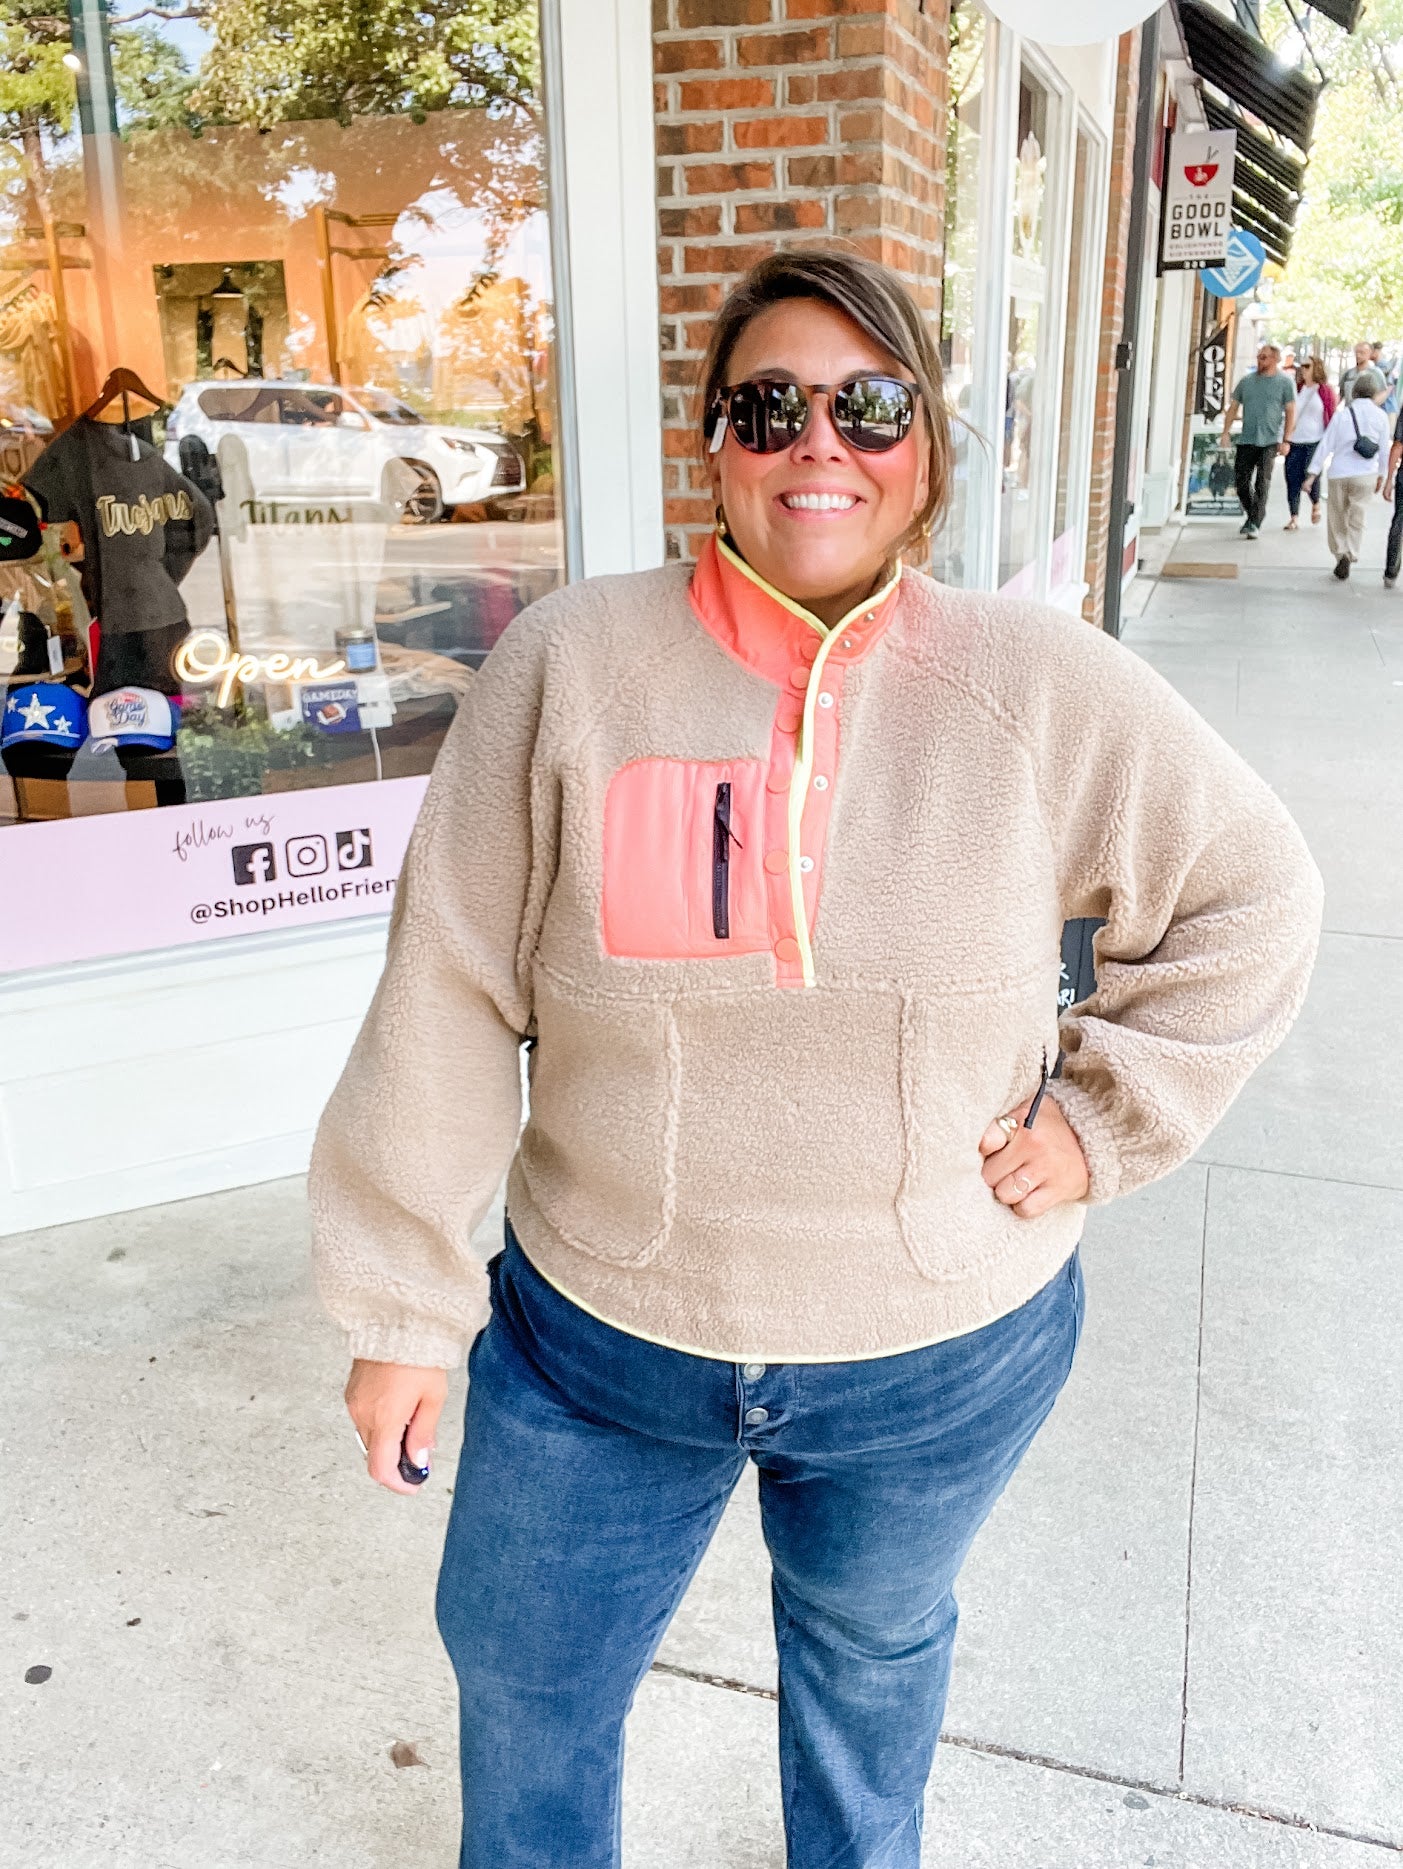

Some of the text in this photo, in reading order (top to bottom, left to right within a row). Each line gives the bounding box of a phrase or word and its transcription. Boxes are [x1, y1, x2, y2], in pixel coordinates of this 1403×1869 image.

[1171, 222, 1223, 239] BOWL
[1172, 202, 1226, 220] GOOD
[1203, 345, 1226, 412] OPEN
[175, 632, 346, 709] Open
[172, 814, 276, 862] follow us
